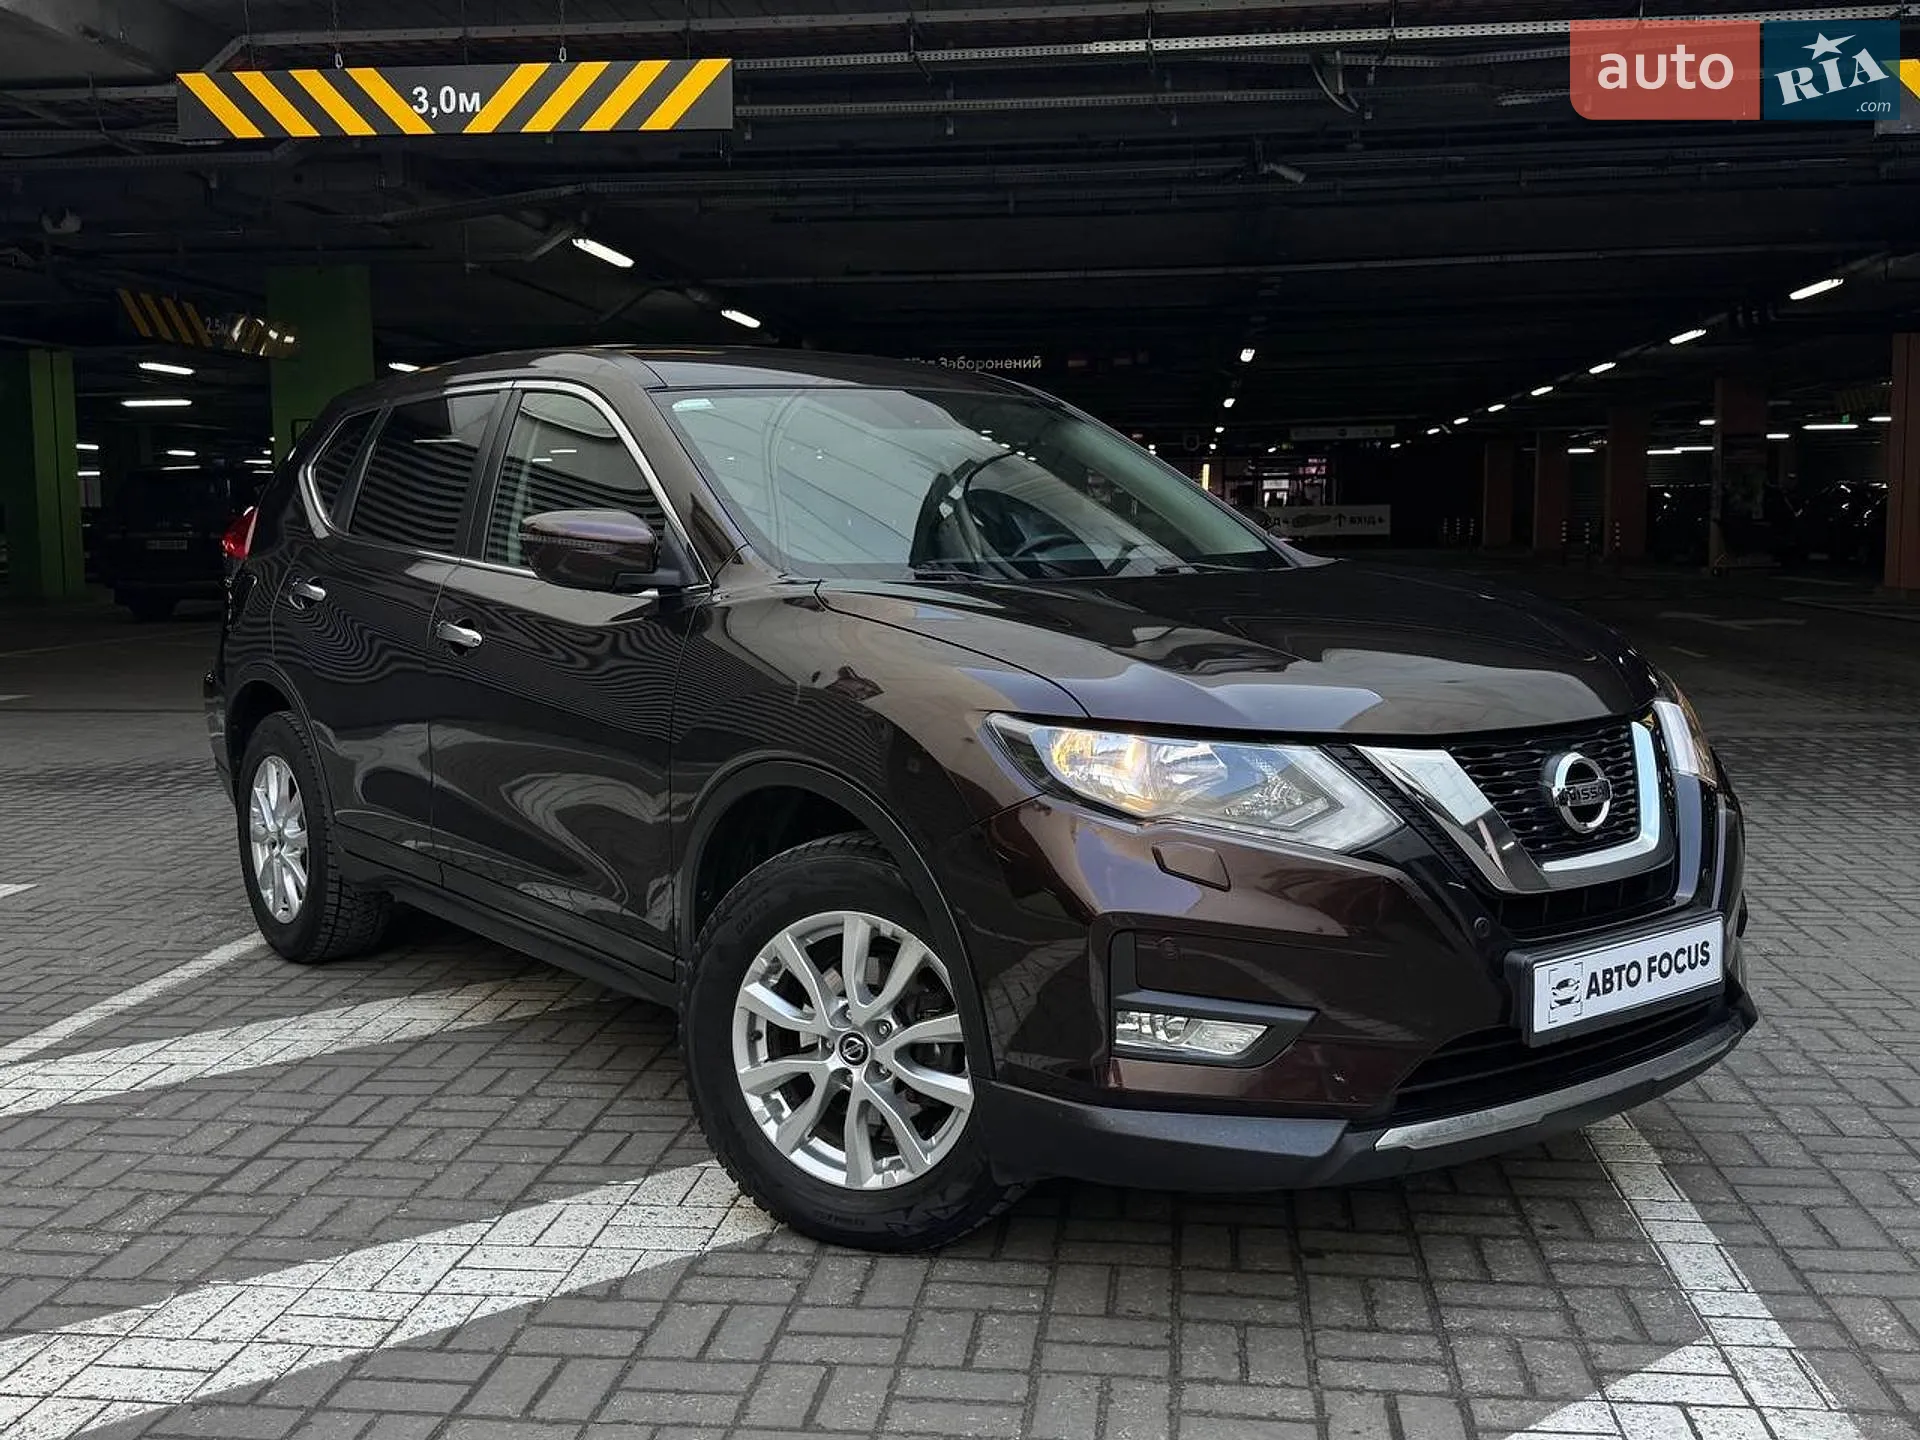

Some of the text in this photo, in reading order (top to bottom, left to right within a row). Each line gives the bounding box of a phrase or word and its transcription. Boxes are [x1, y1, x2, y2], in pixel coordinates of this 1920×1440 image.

[412, 85, 480, 118] 3,0м
[938, 355, 1042, 372] Заборонений
[1647, 940, 1710, 983] FOCUS
